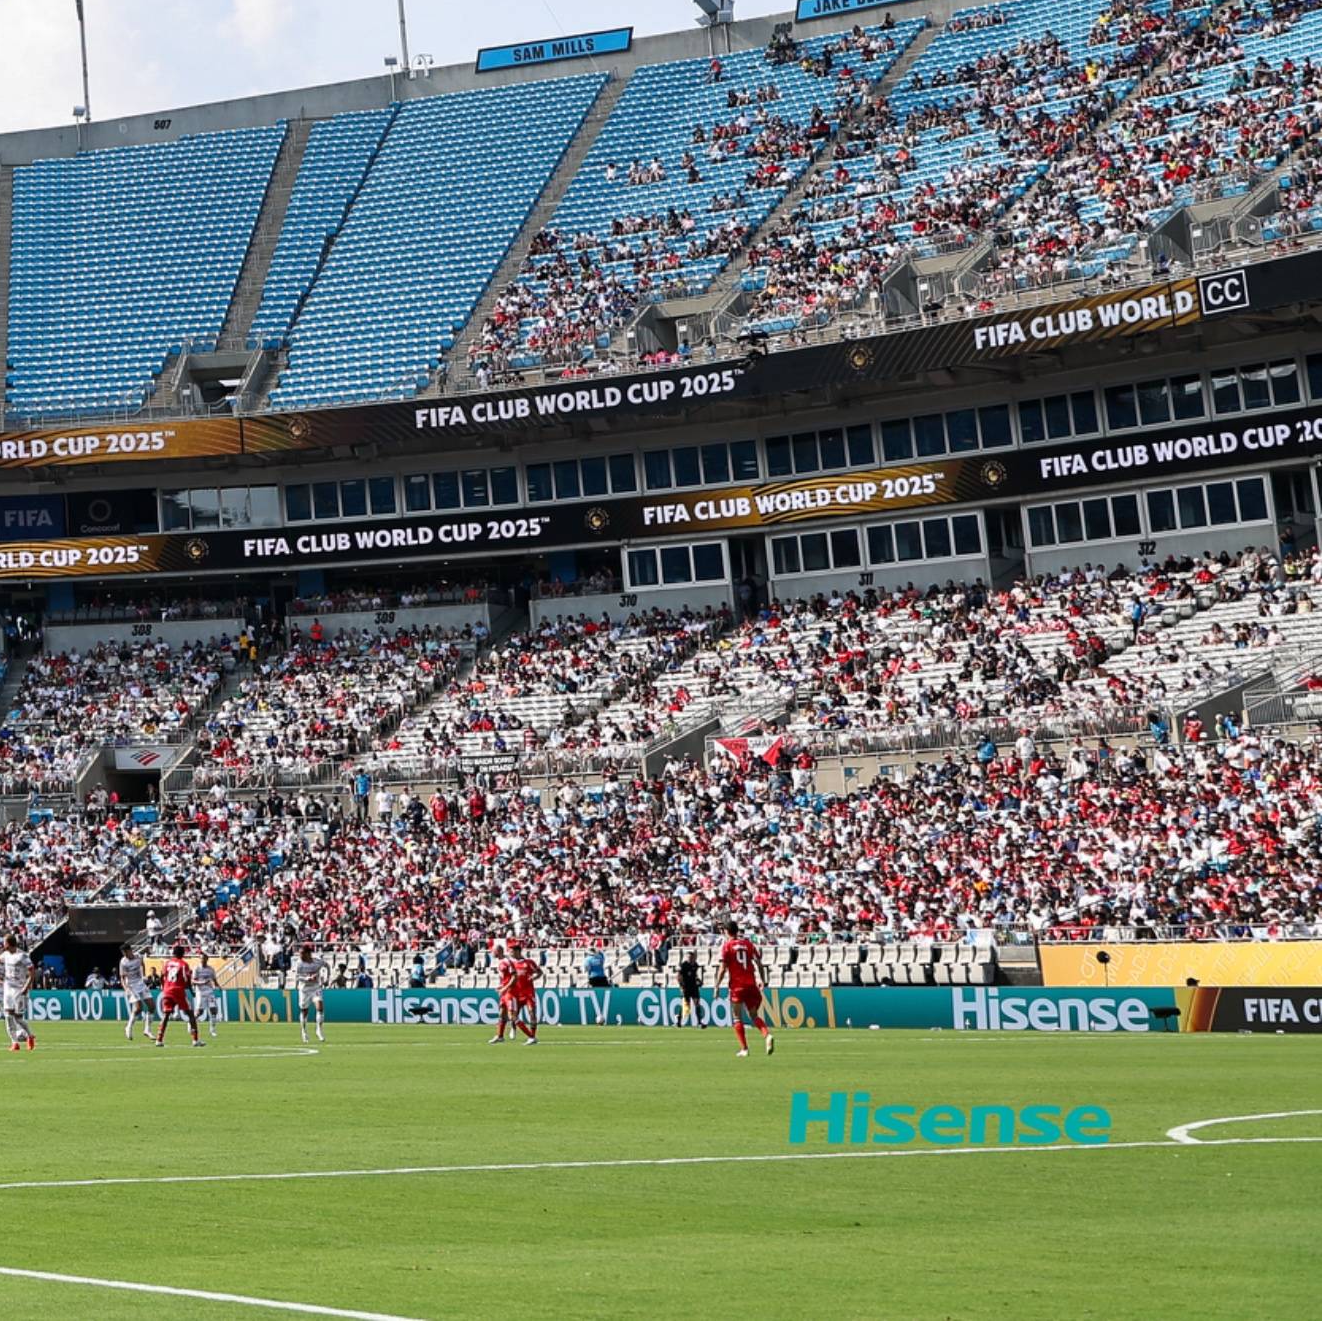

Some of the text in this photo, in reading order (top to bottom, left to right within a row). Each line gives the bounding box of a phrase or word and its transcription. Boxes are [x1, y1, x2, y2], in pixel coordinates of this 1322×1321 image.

[513, 38, 595, 62] SAM MILLS
[1207, 279, 1241, 305] CC
[974, 290, 1193, 350] FIFA CLUB WORLD
[415, 403, 466, 428] FIFA
[471, 396, 530, 423] CLUB
[535, 387, 622, 416] WORLD
[627, 380, 674, 404] CUP
[53, 436, 99, 456] CUP
[1040, 424, 1291, 479] FIFA CLUB WORLD CUP
[4, 509, 53, 527] FIFA
[643, 504, 690, 525] FIFA
[694, 497, 750, 519] CLUB
[756, 489, 830, 514] WORLD
[835, 482, 876, 504] CUP
[244, 537, 293, 556] FIFA
[297, 531, 350, 553] CLUB
[355, 526, 433, 550] WORLD
[438, 523, 482, 544] CUP
[40, 548, 80, 567] CUP
[372, 990, 499, 1024] Hisense
[952, 987, 1299, 1031] Hisense FIFA
